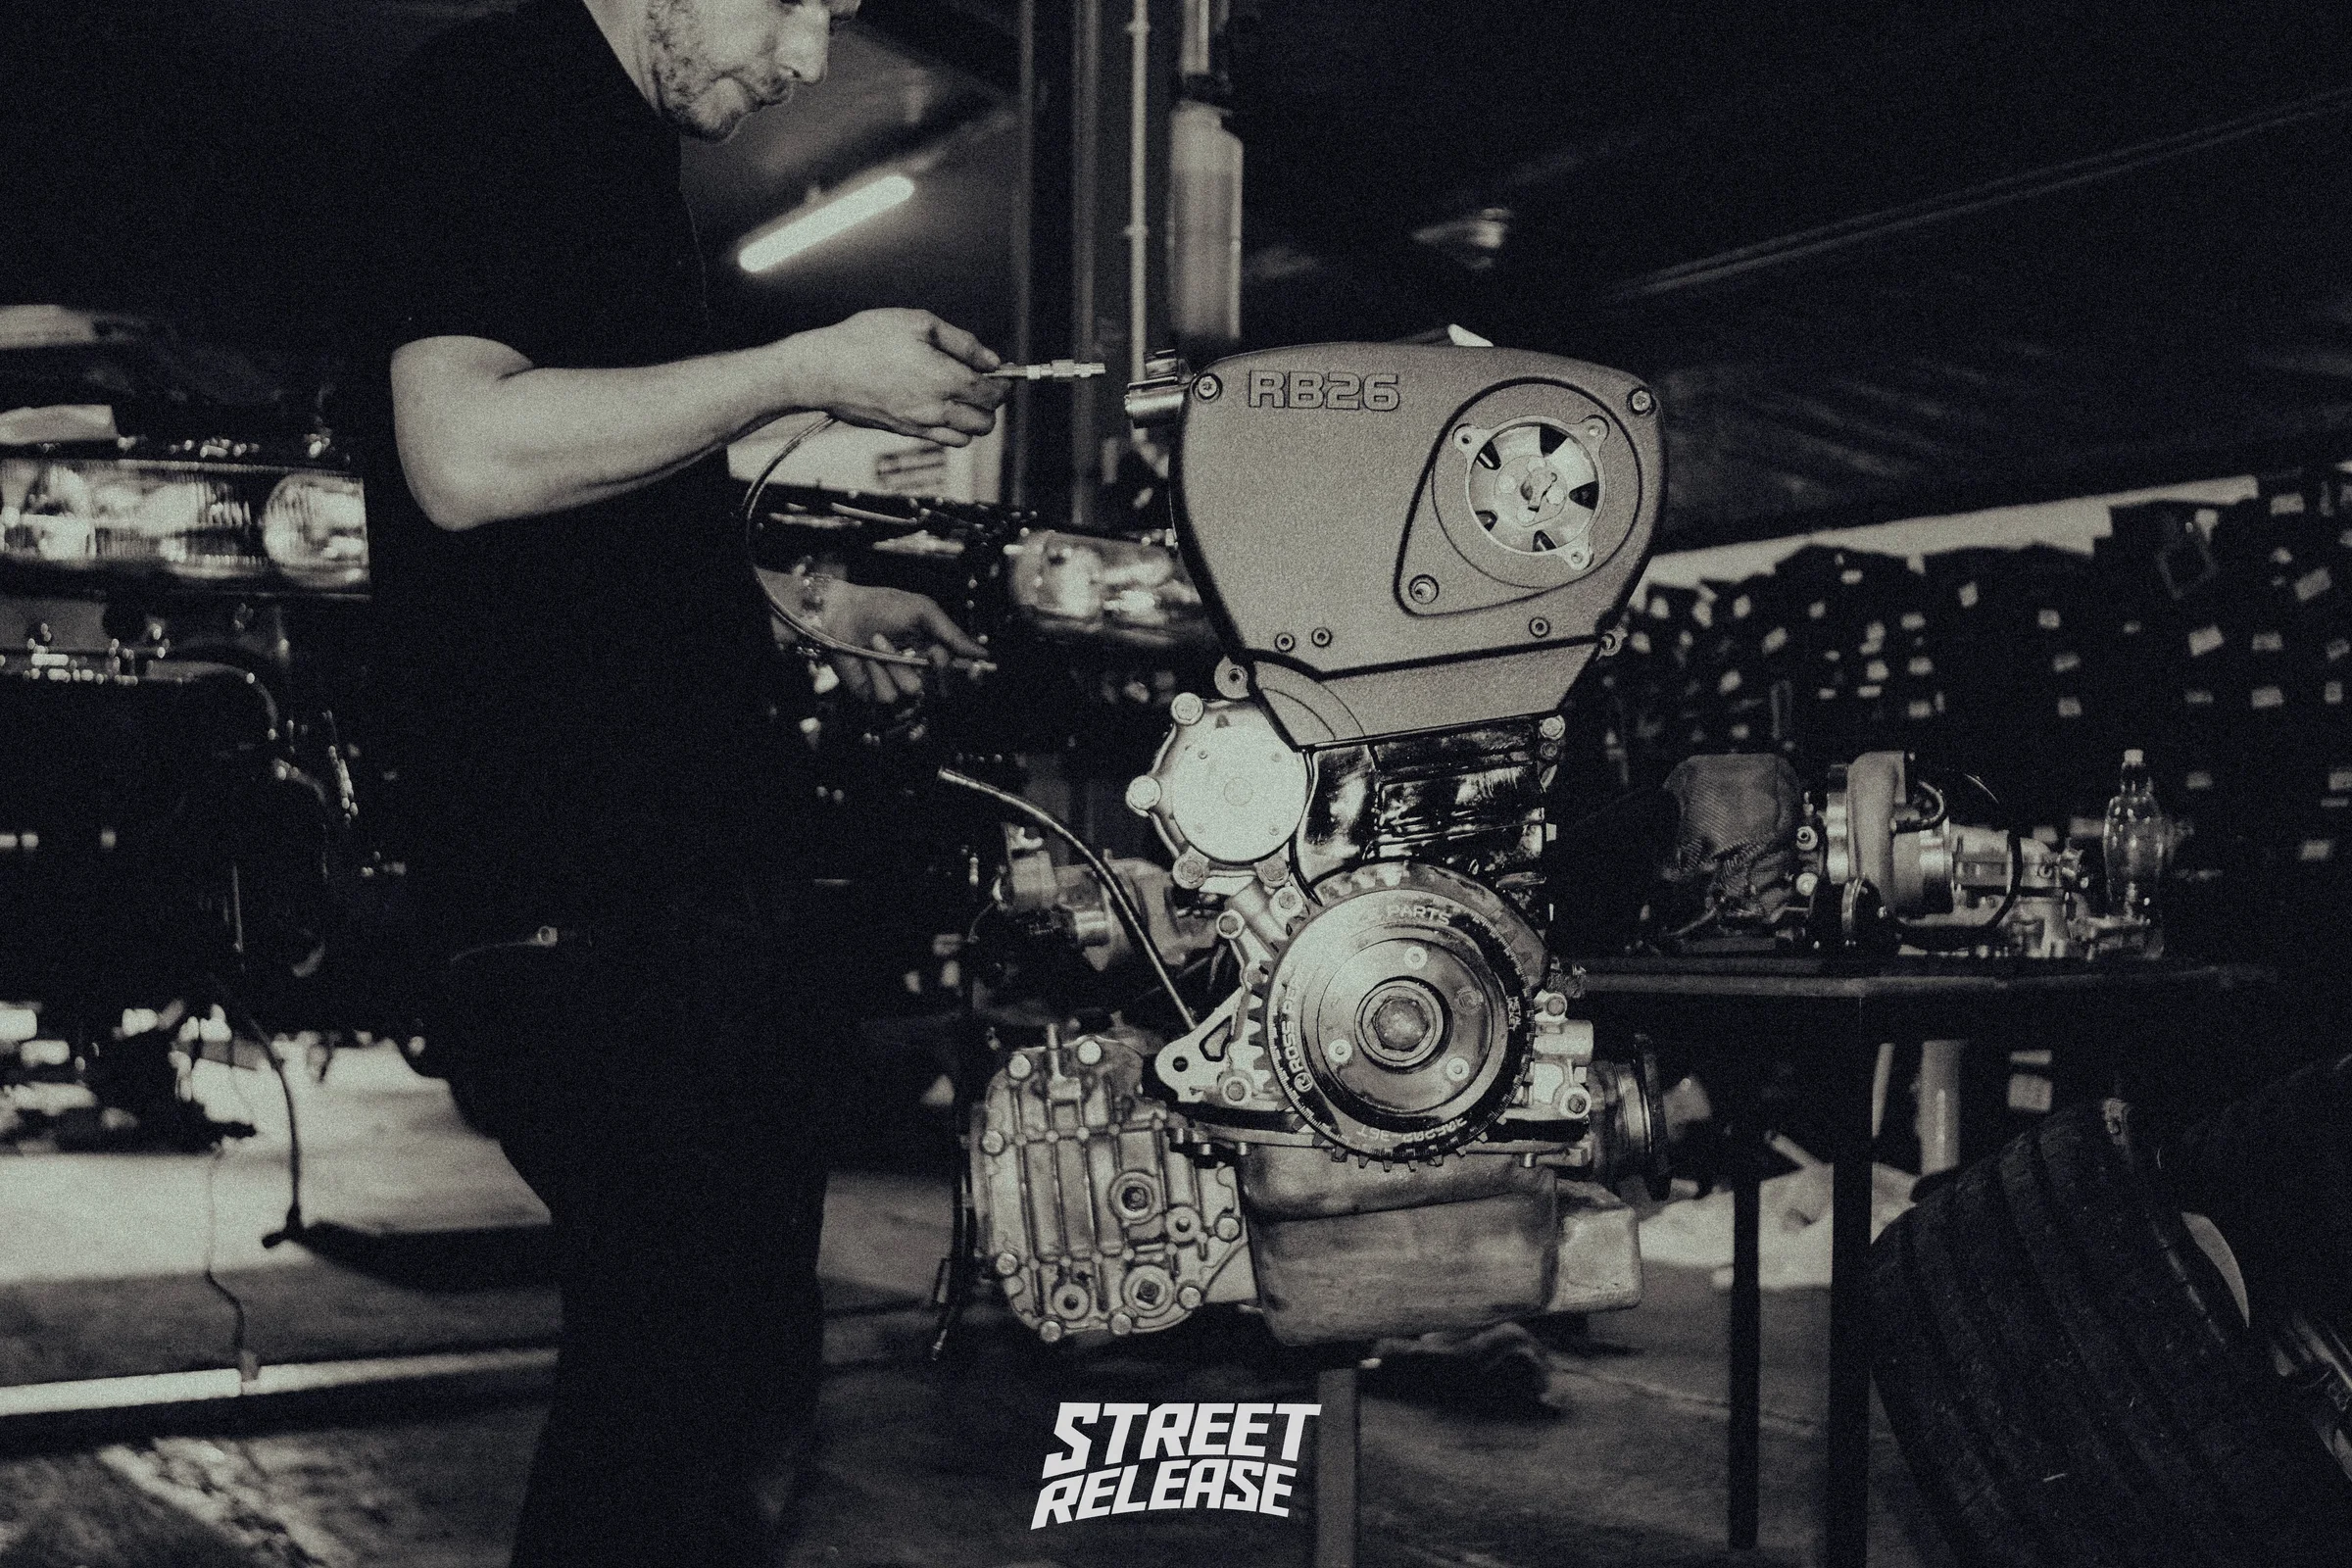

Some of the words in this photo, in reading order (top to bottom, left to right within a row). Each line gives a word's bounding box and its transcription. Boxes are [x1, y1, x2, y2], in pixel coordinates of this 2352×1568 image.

[1249, 369, 1400, 413] RB26
[1387, 905, 1452, 926] PARTS
[1281, 1020, 1304, 1074] ROSS
